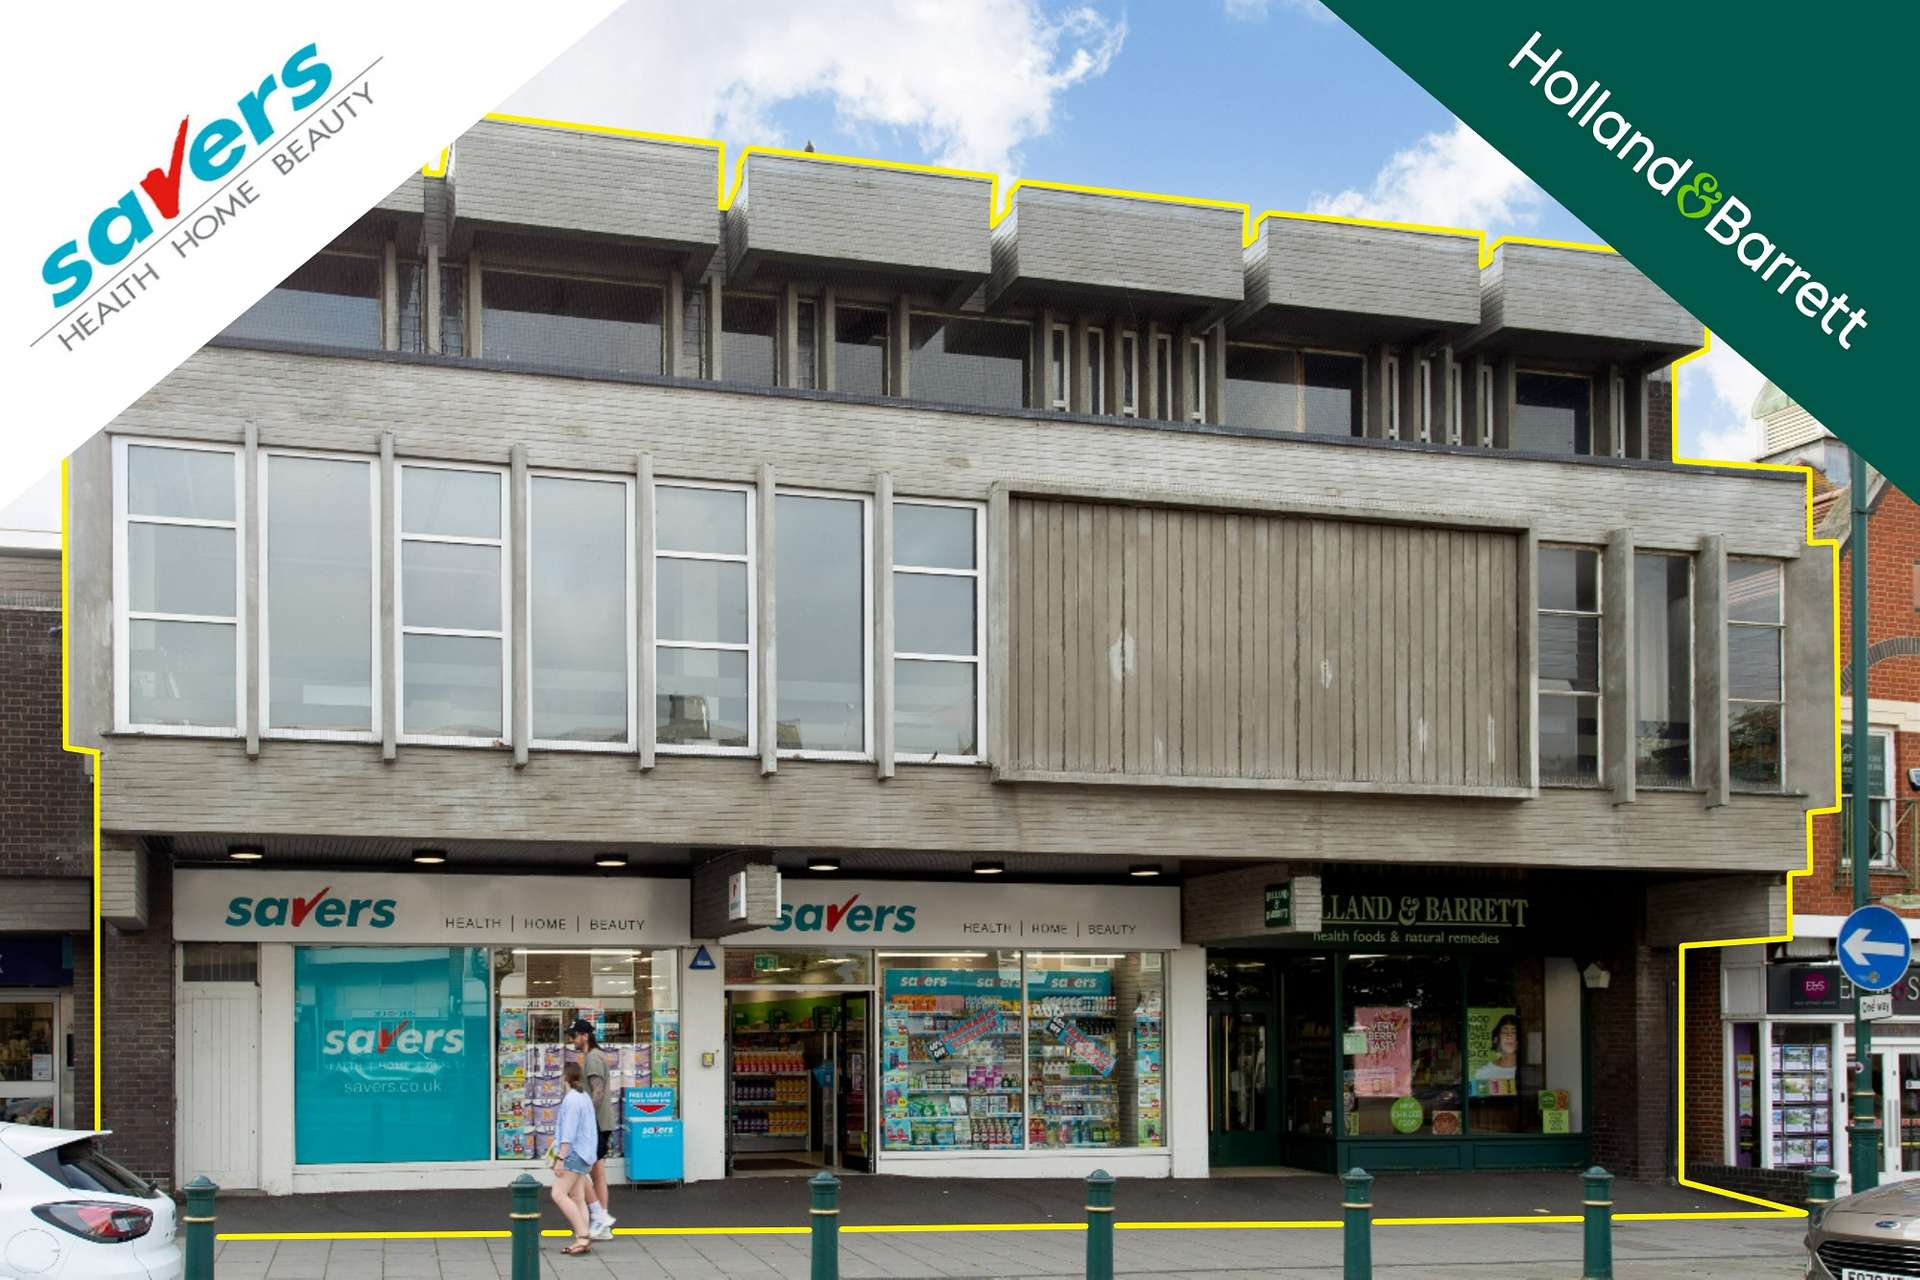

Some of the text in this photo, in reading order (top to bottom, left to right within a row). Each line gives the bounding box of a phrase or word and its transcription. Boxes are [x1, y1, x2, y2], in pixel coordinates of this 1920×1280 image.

[225, 886, 397, 929] savers
[1398, 896, 1420, 926] &
[1425, 896, 1529, 928] BARRETT
[445, 917, 646, 931] HEALTH HOME BEAUTY
[963, 922, 1137, 935] HEALTH HOME BEAUTY
[1313, 929, 1500, 944] health foods & natural remedies
[900, 975, 948, 987] savers
[1051, 976, 1097, 988] savers
[322, 1018, 465, 1055] savers
